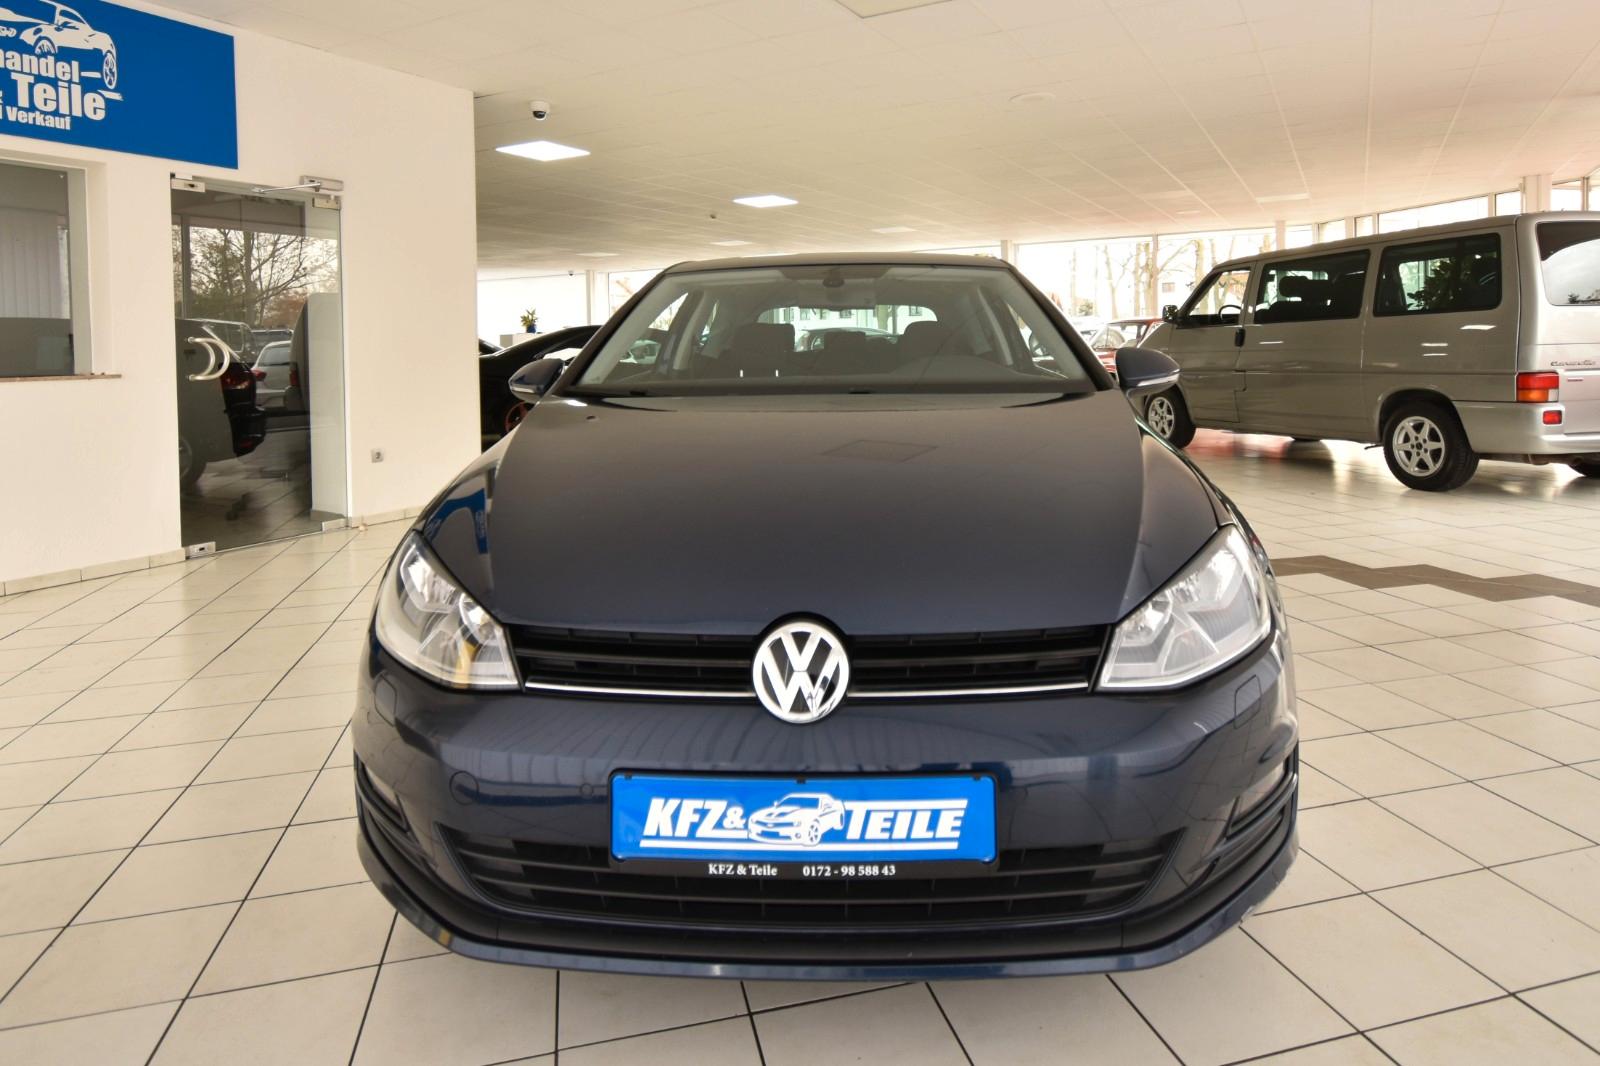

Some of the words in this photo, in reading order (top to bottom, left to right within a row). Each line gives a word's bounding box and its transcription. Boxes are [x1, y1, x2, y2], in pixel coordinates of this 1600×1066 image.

[0, 48, 80, 83] andel
[11, 72, 106, 121] Teile
[6, 105, 71, 130] Verkauf
[843, 799, 967, 840] TEILE
[708, 863, 735, 875] KFZ
[736, 863, 747, 876] &
[748, 864, 778, 876] Teile
[802, 865, 831, 877] 0172
[840, 865, 856, 877] 98
[857, 865, 879, 877] 588
[880, 864, 896, 876] 43
